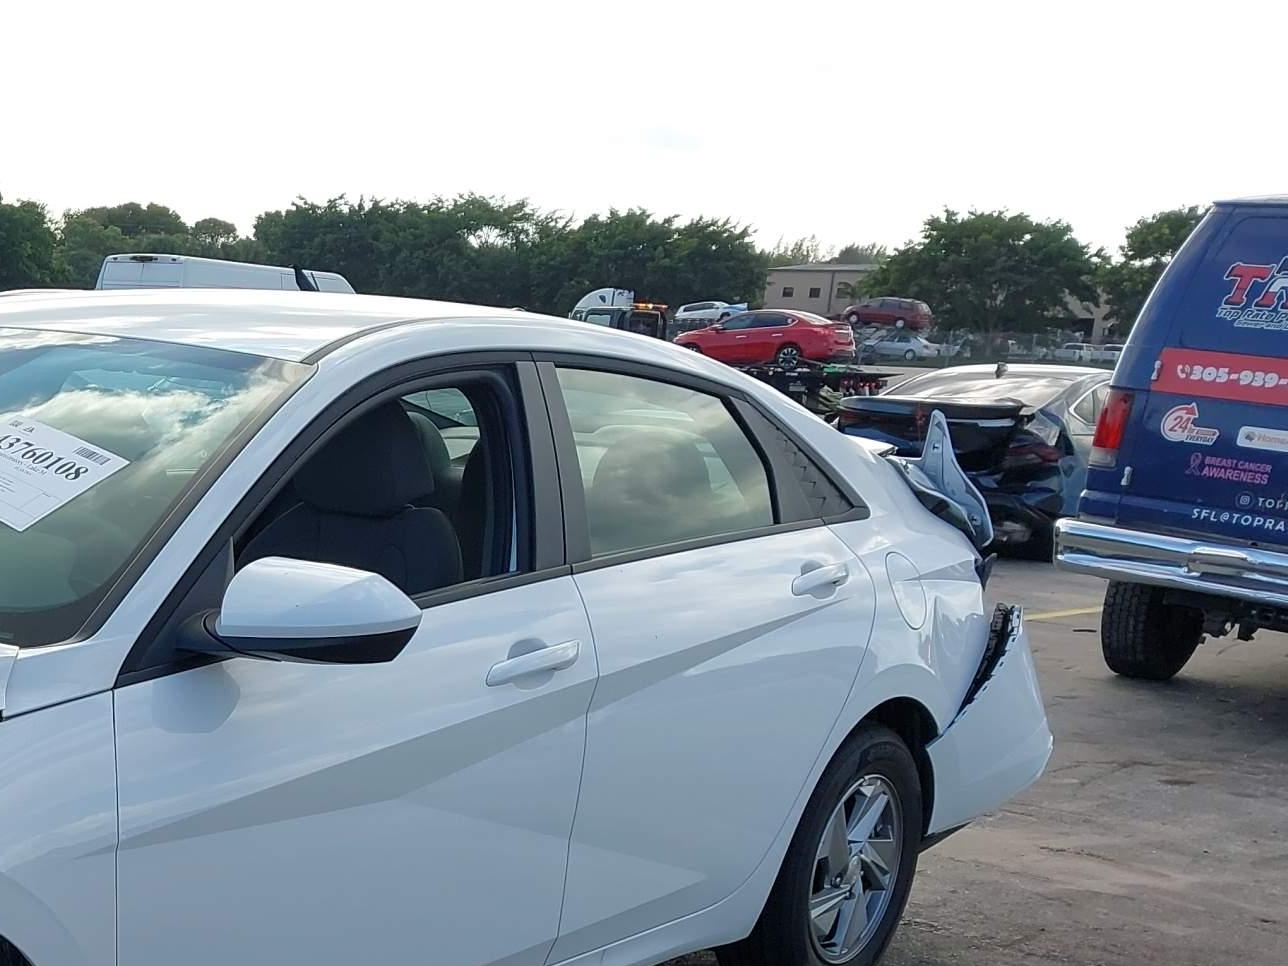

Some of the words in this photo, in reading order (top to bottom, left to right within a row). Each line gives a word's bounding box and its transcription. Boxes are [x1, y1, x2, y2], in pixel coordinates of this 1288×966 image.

[1168, 416, 1190, 433] 24
[1204, 456, 1238, 469] BREAST
[1237, 460, 1273, 473] CANCER
[1202, 467, 1269, 485] AWARENESS
